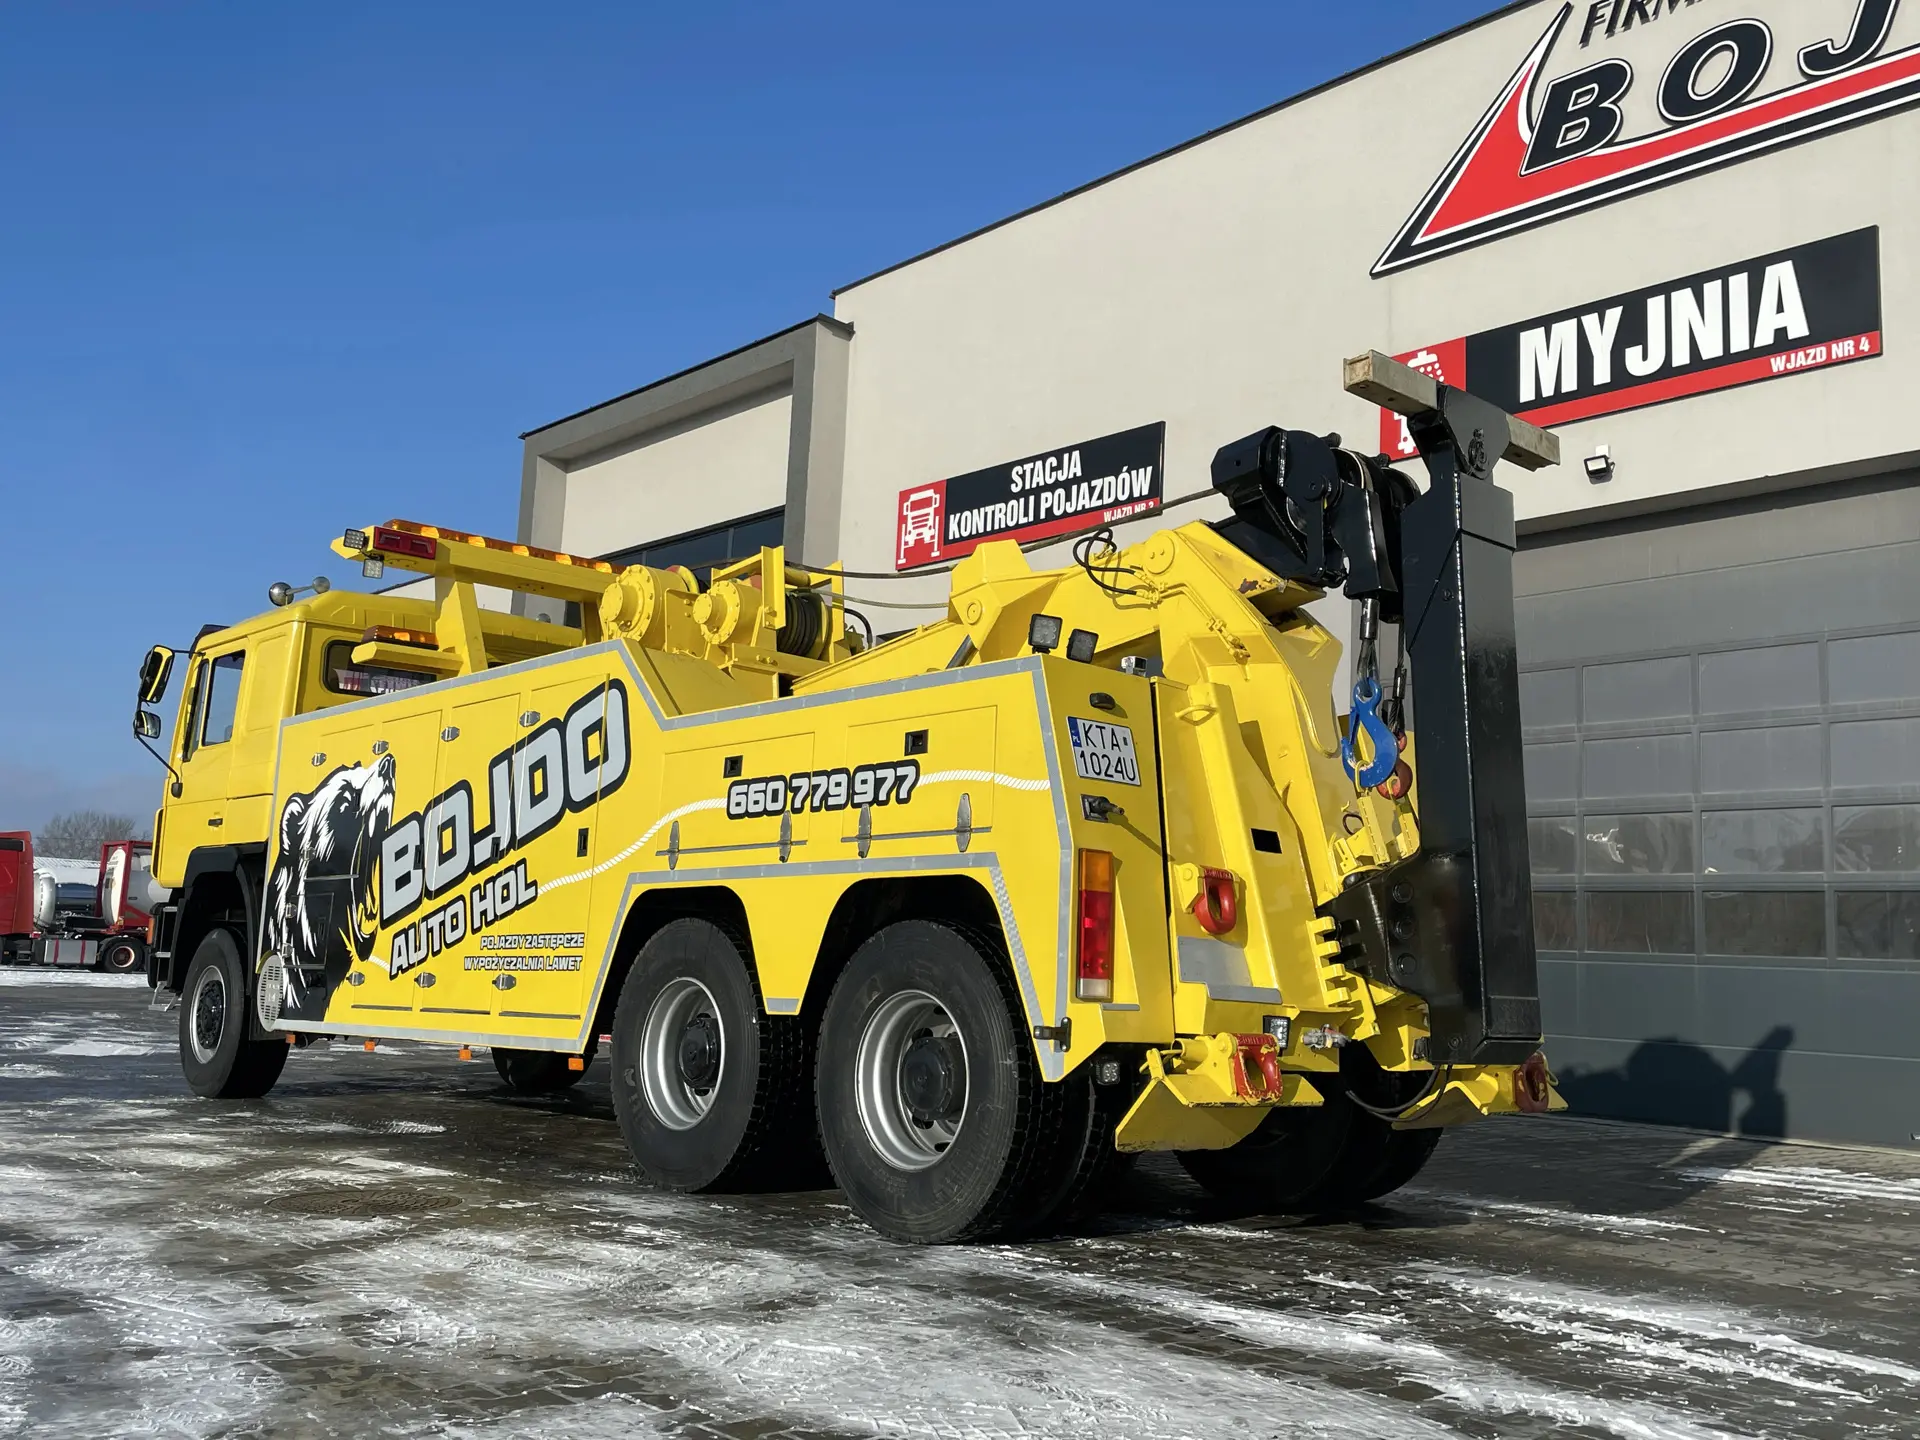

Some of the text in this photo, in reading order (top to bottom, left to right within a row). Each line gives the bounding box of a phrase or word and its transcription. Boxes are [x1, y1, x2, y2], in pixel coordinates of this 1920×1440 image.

[1579, 0, 1701, 48] FIR
[1519, 259, 1810, 403] MYJNIA
[1770, 336, 1871, 373] WJAZD NR 4
[1010, 449, 1082, 493] STACJA
[948, 465, 1153, 540] KONTROLI POJAZDÓW
[1134, 502, 1147, 514] NR
[1082, 722, 1122, 752] KTA
[1079, 750, 1136, 782] 1024U
[380, 678, 632, 930] BOJDO
[726, 758, 921, 821] 660 779 977
[389, 858, 538, 981] AUTO HOL
[480, 932, 585, 950] POJAZDY ZASTĘPCZE
[463, 953, 583, 971] WYPOŻYCZALNIA LAWET
